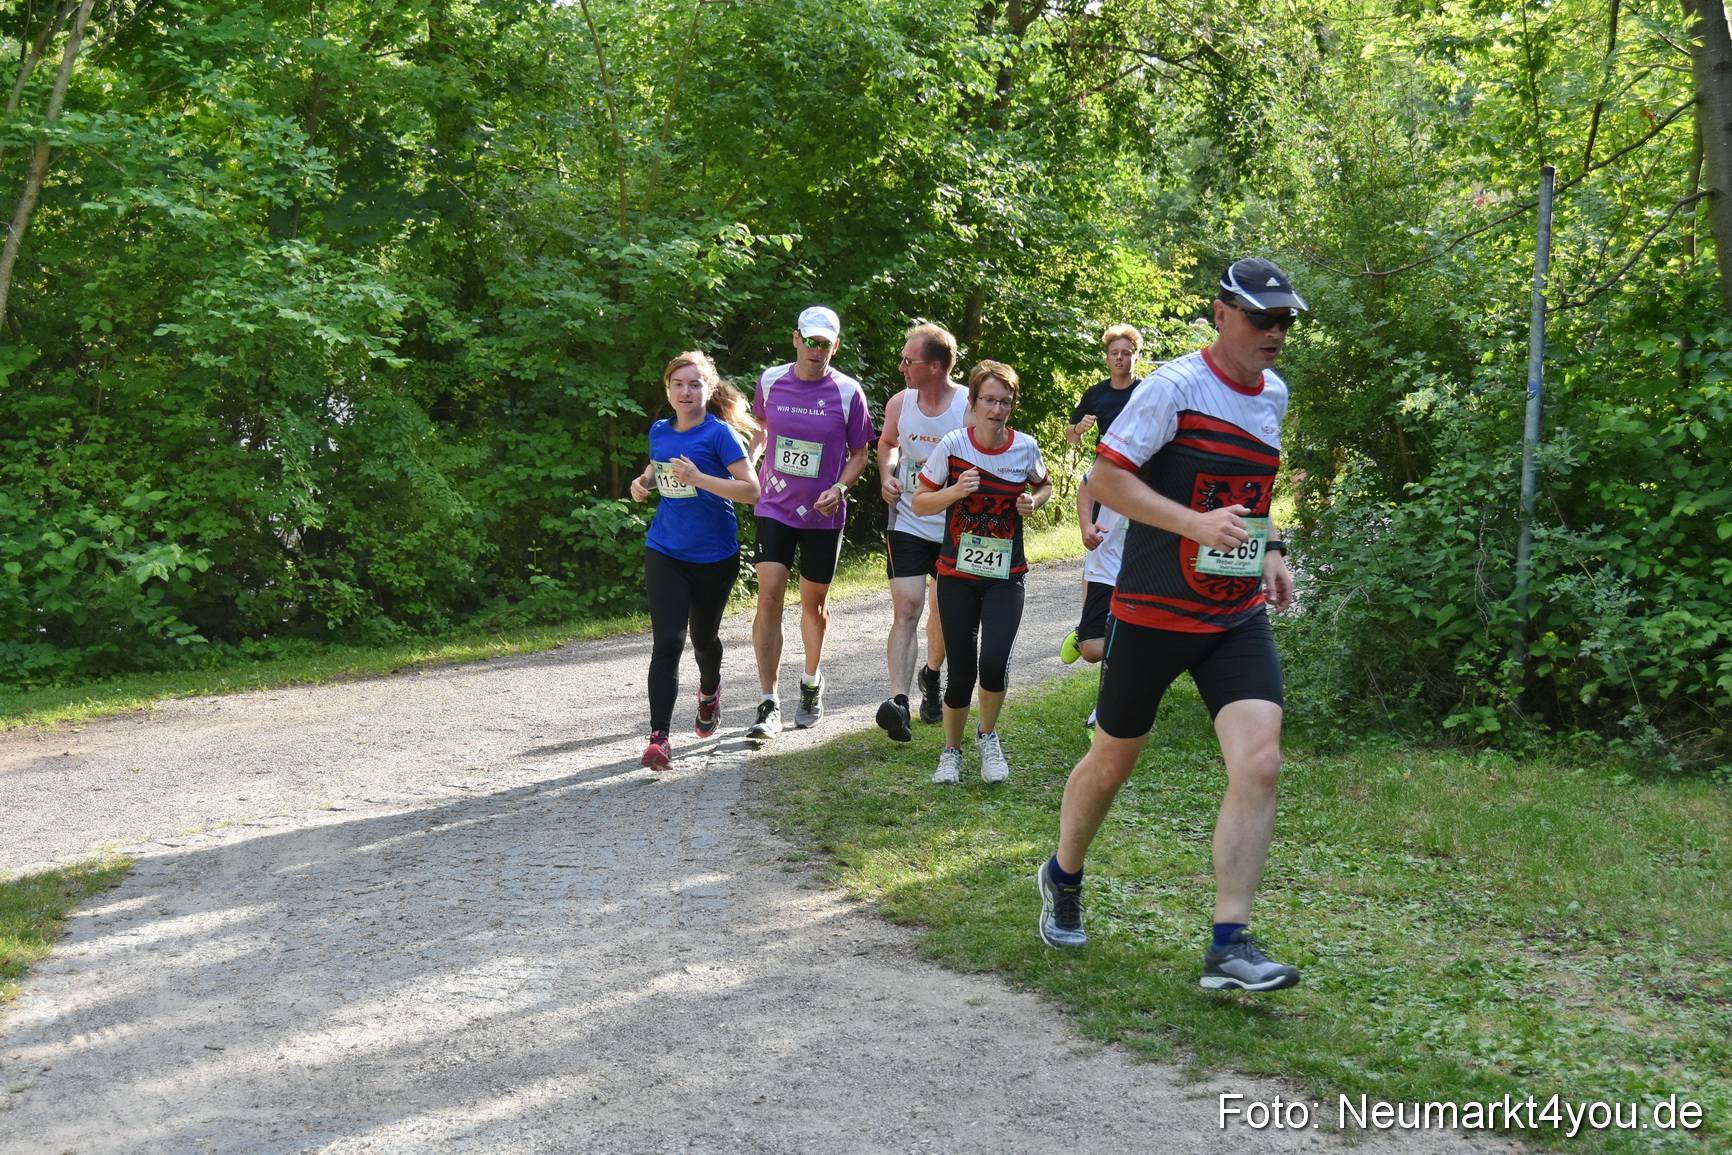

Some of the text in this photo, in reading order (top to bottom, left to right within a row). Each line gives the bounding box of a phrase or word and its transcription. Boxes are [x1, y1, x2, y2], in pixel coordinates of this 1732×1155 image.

[920, 435, 942, 443] KLE
[783, 450, 809, 467] 878
[963, 548, 1003, 567] 2241
